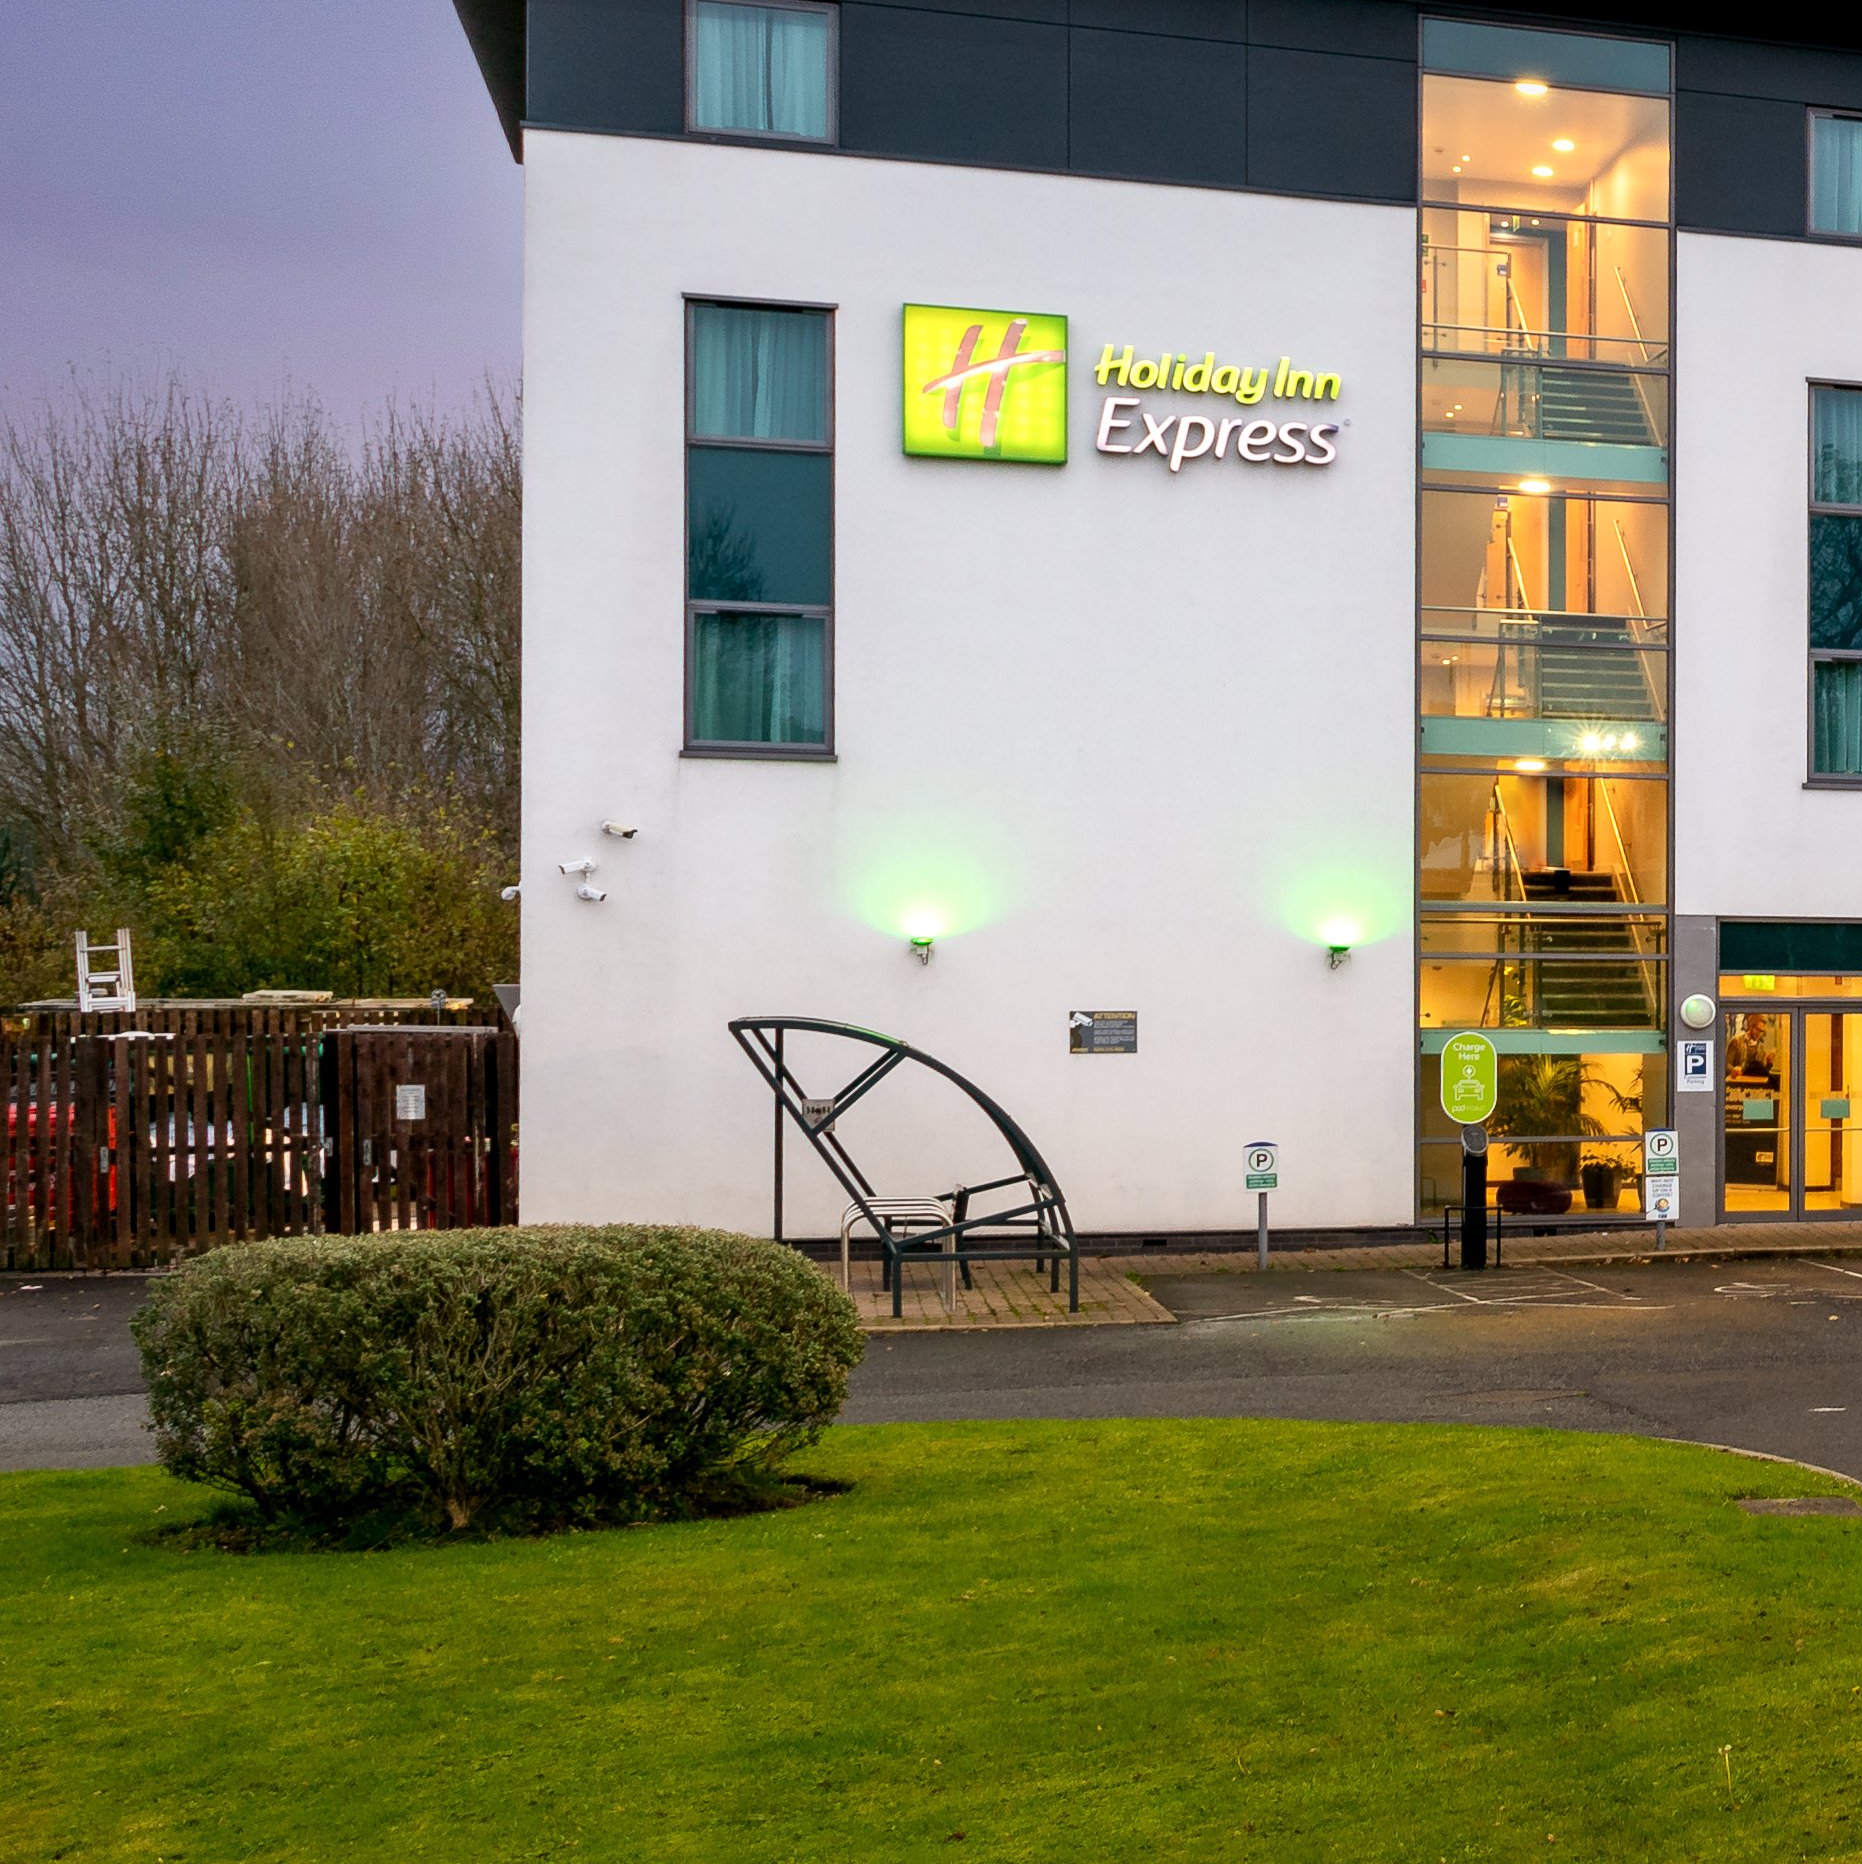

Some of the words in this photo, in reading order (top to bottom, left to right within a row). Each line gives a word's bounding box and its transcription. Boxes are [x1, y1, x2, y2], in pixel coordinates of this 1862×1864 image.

[1094, 343, 1269, 405] Holiday
[1273, 355, 1342, 400] Inn
[1096, 396, 1340, 472] Express
[1453, 1042, 1486, 1053] Charge
[1458, 1052, 1480, 1061] Here
[1686, 1054, 1705, 1074] P
[1657, 1138, 1668, 1152] P
[1256, 1153, 1268, 1168] P
